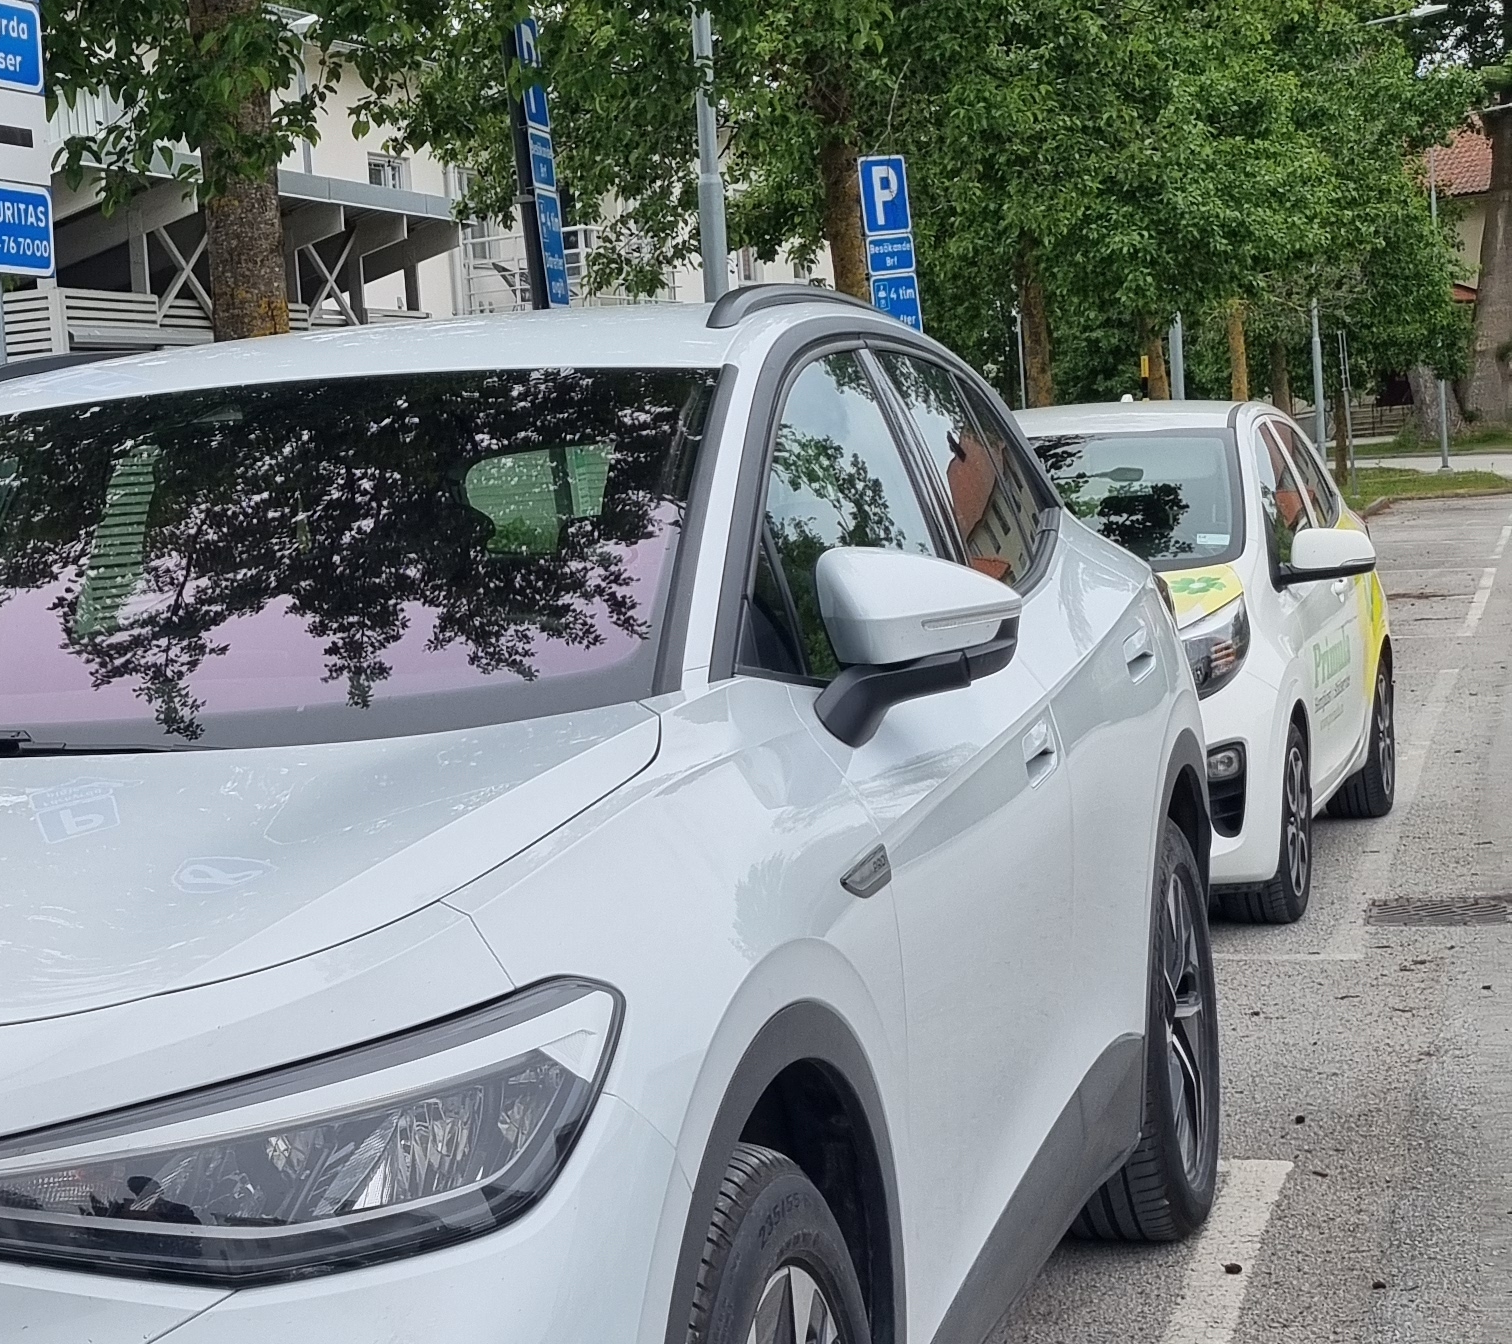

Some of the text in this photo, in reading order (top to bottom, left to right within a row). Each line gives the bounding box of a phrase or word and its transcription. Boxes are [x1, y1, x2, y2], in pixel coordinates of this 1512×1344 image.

[871, 165, 898, 226] P
[869, 241, 911, 254] Besökande
[889, 286, 915, 301] 4 tim
